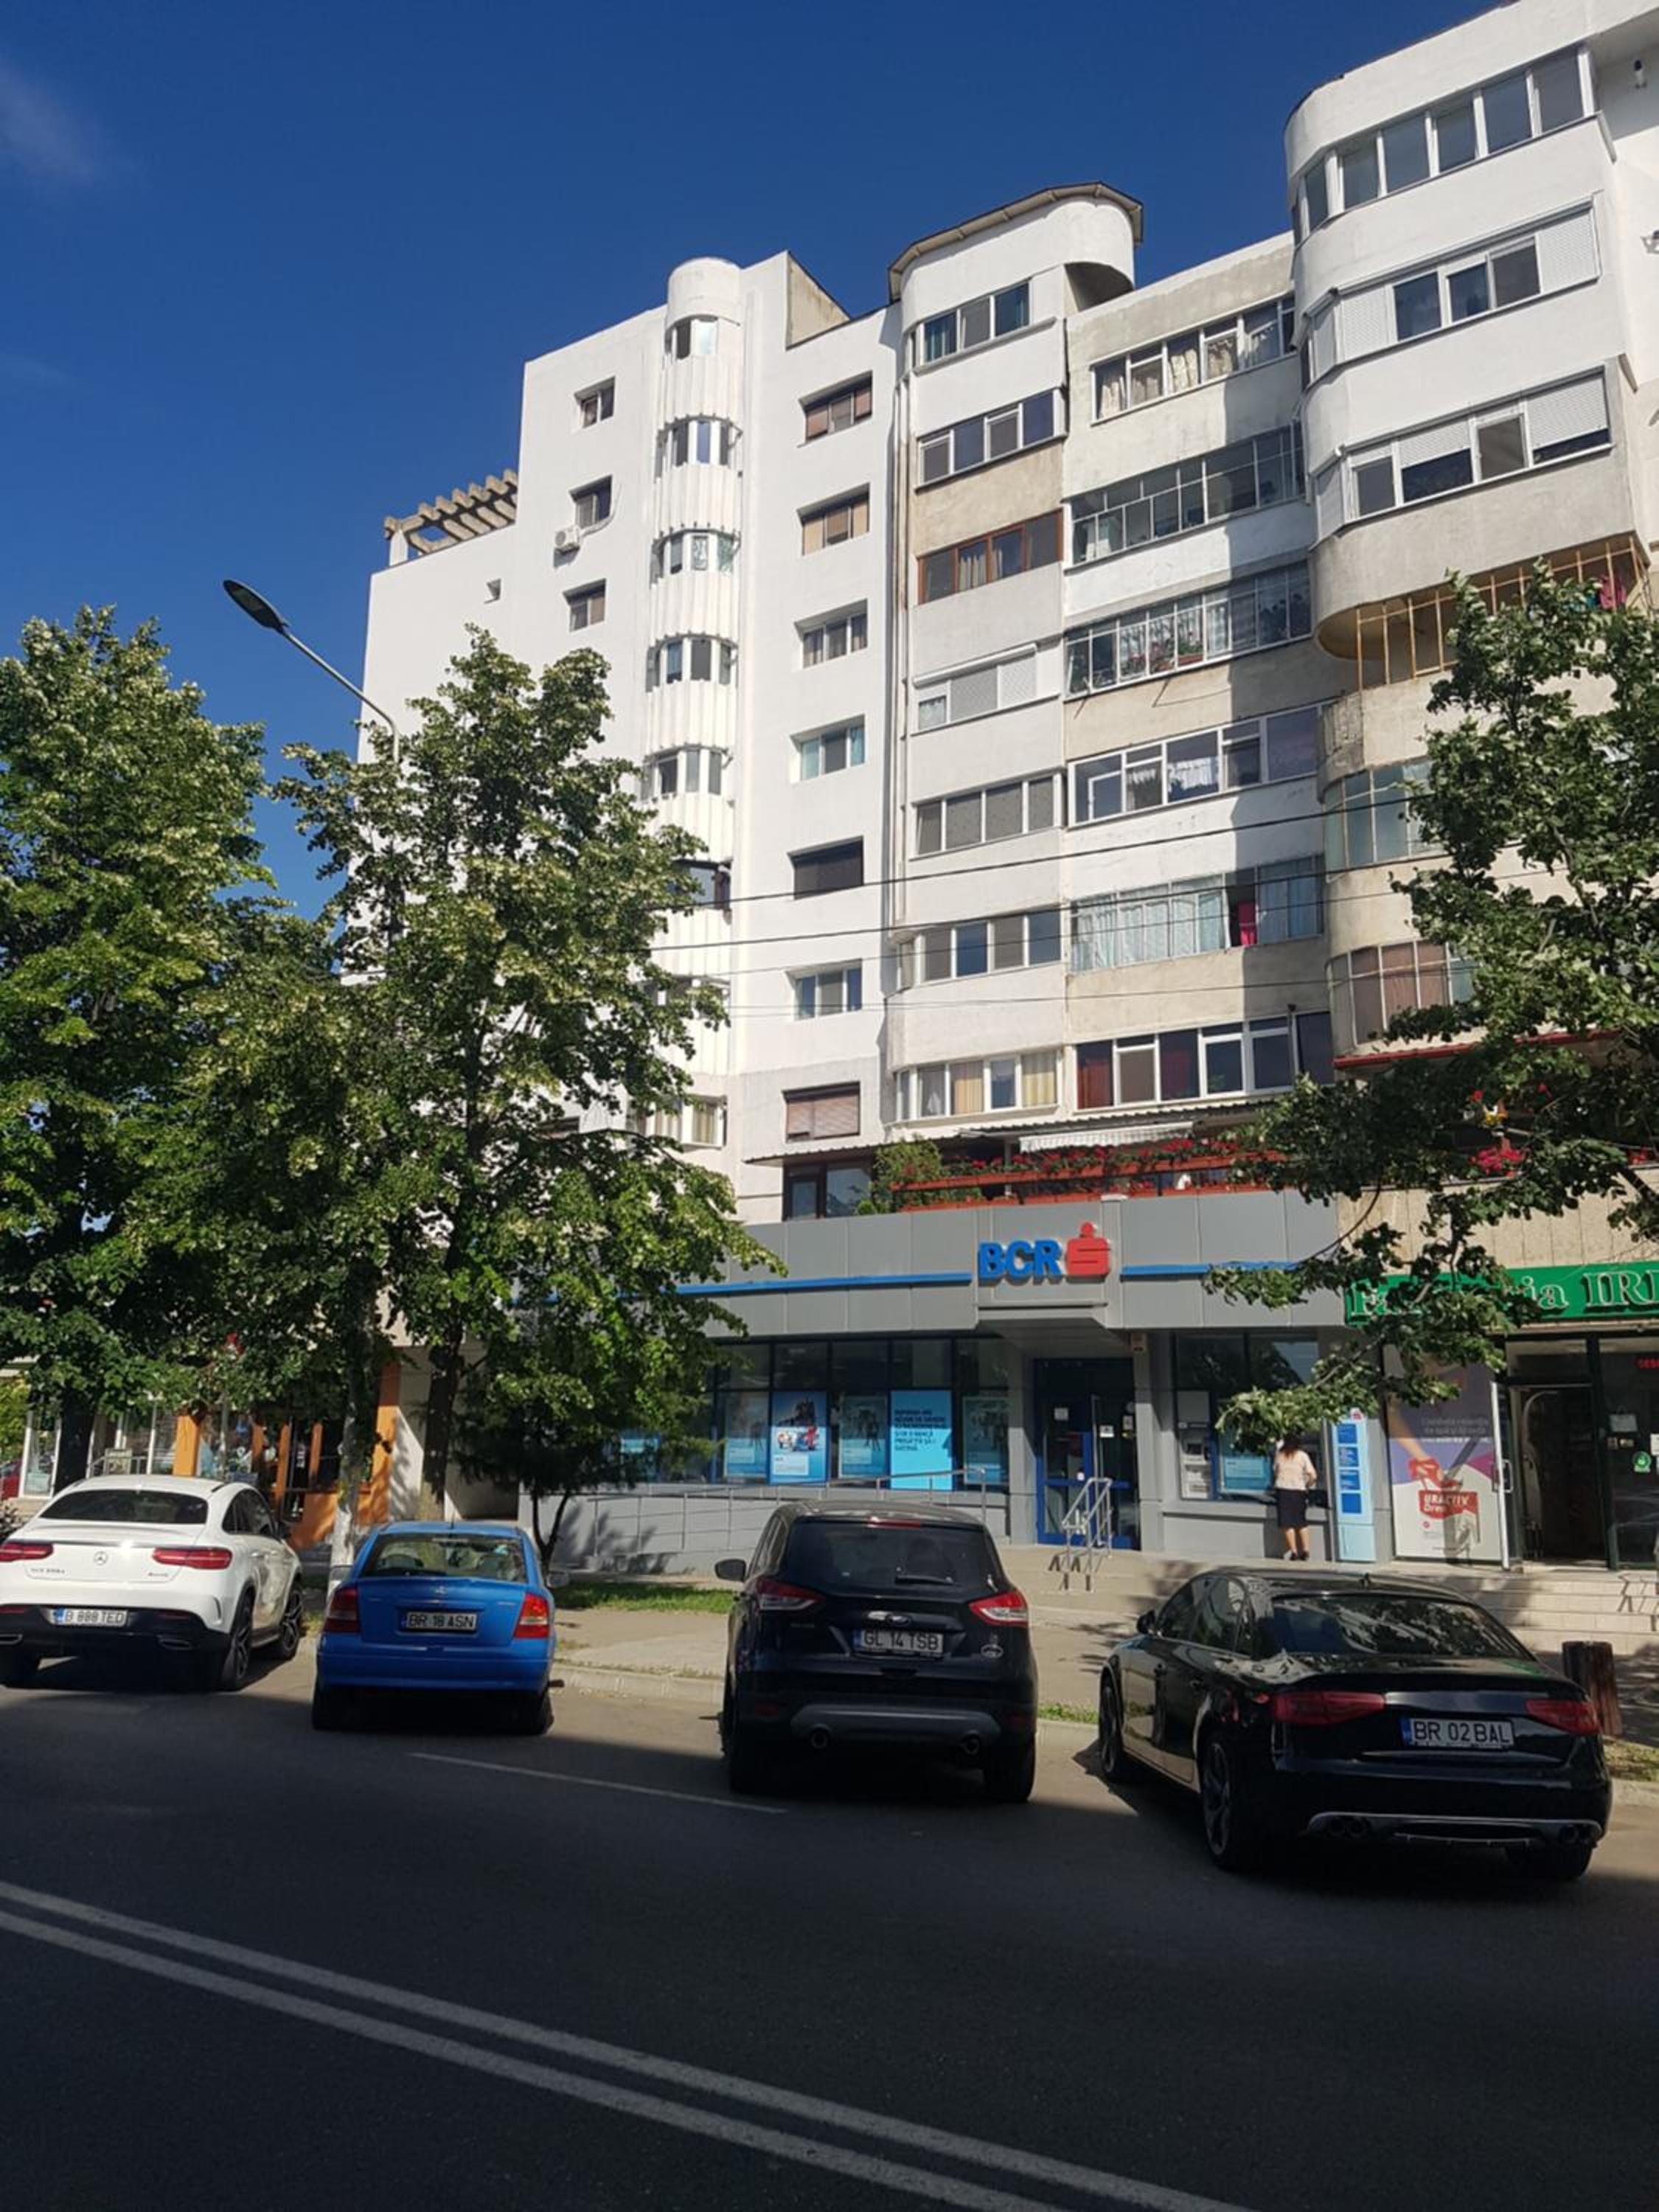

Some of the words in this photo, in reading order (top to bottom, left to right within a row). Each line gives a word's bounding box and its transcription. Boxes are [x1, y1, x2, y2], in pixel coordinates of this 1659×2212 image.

[978, 1239, 1062, 1284] BCR
[1424, 1494, 1470, 1506] URACTIV
[409, 1614, 426, 1627] BR
[864, 1630, 883, 1646] GL
[891, 1632, 903, 1647] 14
[909, 1633, 939, 1650] TSB
[1413, 1721, 1440, 1740] BR
[1447, 1722, 1470, 1742] 02
[1473, 1723, 1510, 1743] BAL
